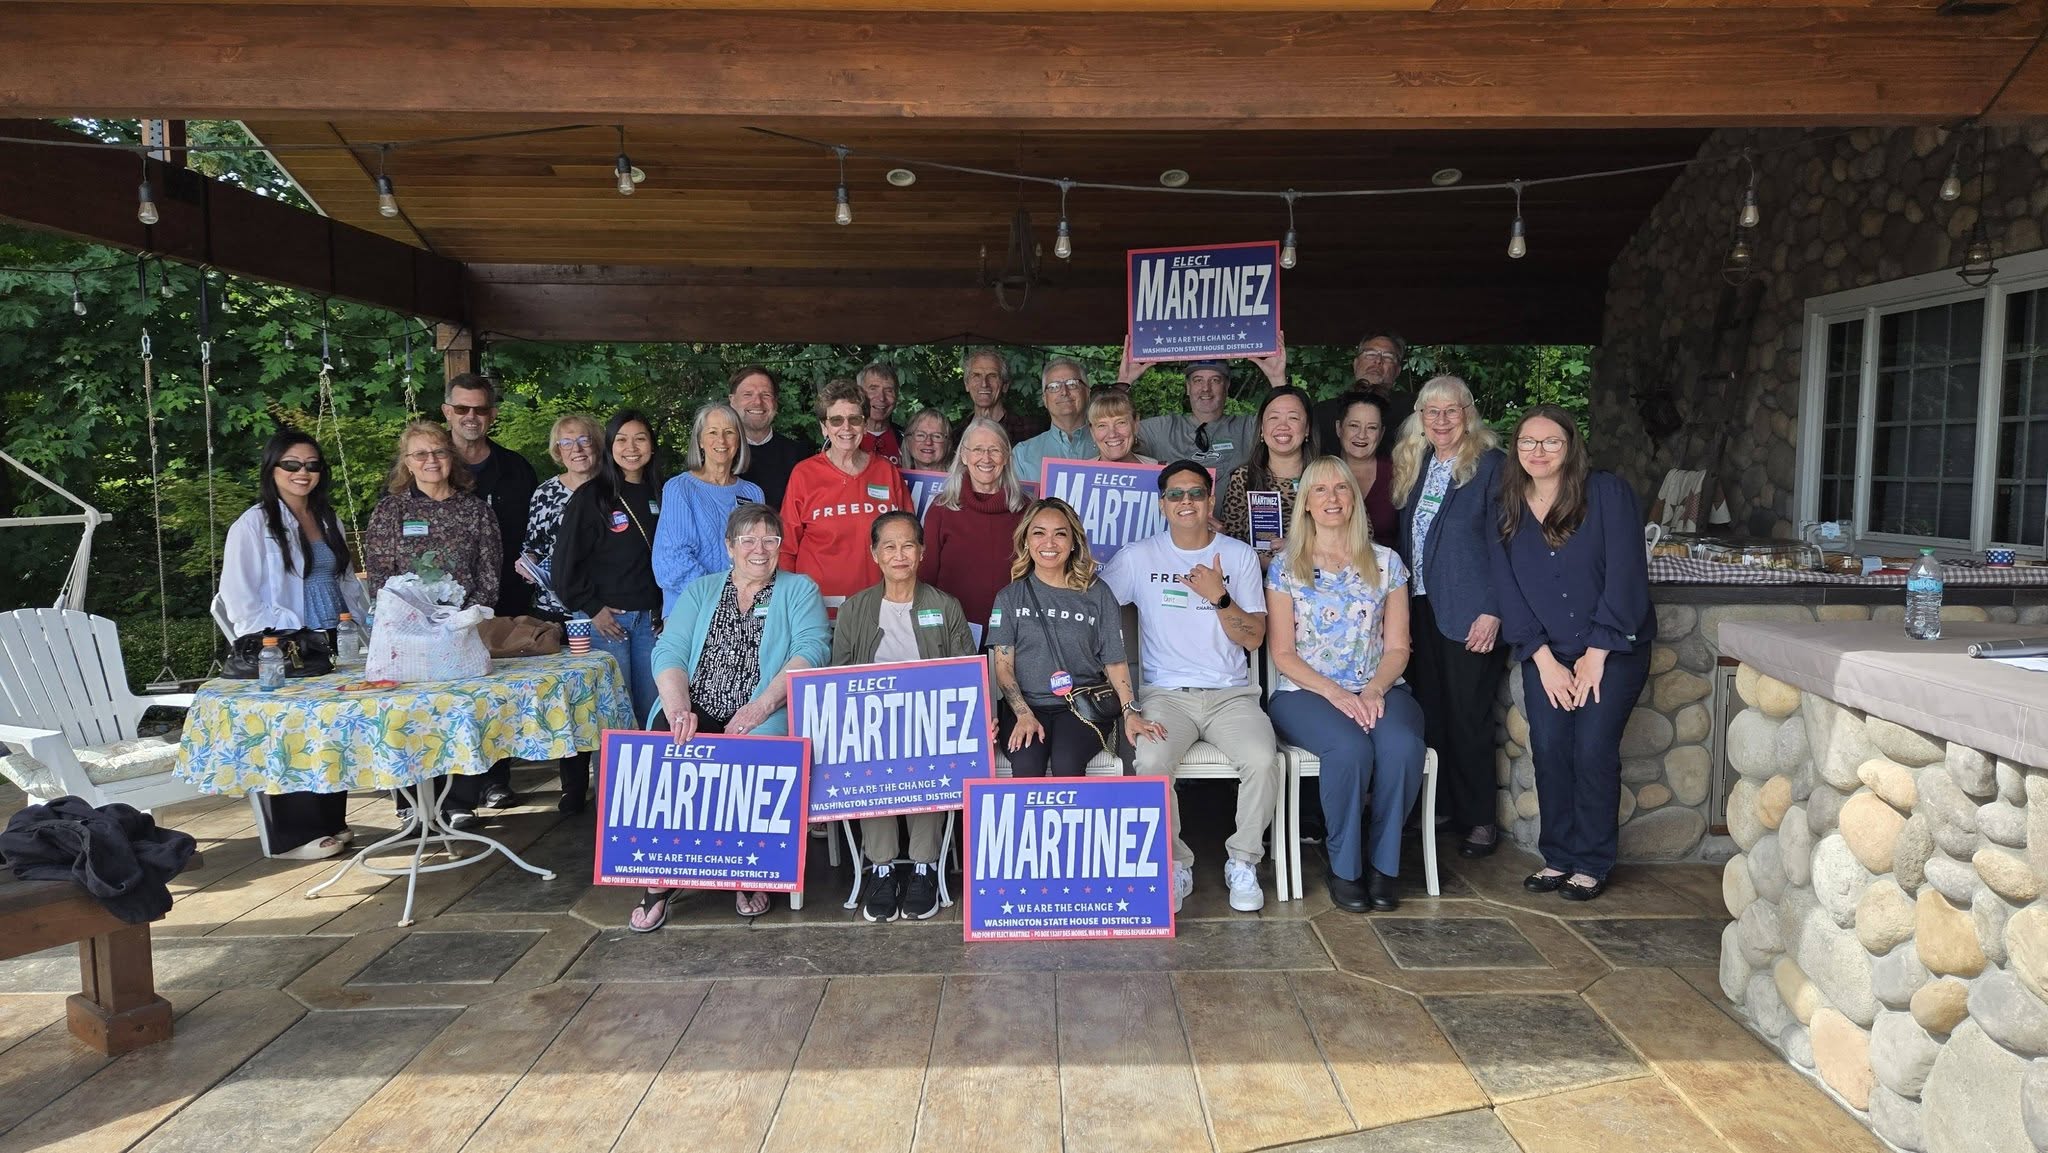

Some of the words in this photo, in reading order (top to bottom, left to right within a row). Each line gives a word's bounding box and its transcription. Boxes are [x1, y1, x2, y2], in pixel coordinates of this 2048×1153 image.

[1173, 255, 1211, 267] ELECT
[1136, 258, 1272, 322] MARTINEZ
[1142, 346, 1184, 354] WASHINGTON
[1094, 473, 1137, 487] ELECT
[812, 503, 898, 520] FREEDOM
[1016, 608, 1095, 626] FREDOM
[848, 676, 897, 692] ELECT
[802, 682, 978, 765] MARTINEZ
[664, 744, 716, 758] ELECT
[608, 743, 797, 834] MARTINEZ
[843, 787, 857, 796] WE
[859, 785, 878, 794] ARE
[879, 784, 896, 792] THE
[898, 780, 936, 791] CHANGE
[811, 799, 867, 811] WASHINGTON
[868, 797, 893, 806] STATE
[894, 794, 922, 804] HOUSE
[926, 791, 962, 801] DISTRICT
[1026, 791, 1077, 805] ELECT
[976, 793, 1160, 880] MARTINEZ
[648, 853, 663, 862] WE
[664, 854, 683, 862] ARE
[685, 854, 703, 863] THE
[704, 855, 743, 864] CHANGE
[615, 865, 672, 875] WASHINGTON
[673, 867, 698, 876] STATE
[699, 868, 728, 877] HOUSE
[731, 869, 768, 878] DISTRICT
[769, 871, 779, 879] 33
[1017, 904, 1032, 912] WE
[1034, 903, 1052, 912] ARE
[1054, 903, 1072, 912] THE
[1074, 902, 1113, 912] CHANGE
[984, 919, 1042, 927] WASHINGTON
[1043, 918, 1068, 926] STATE
[1070, 918, 1099, 926] HOUSE
[1102, 917, 1140, 925] DISTRICT
[1141, 916, 1151, 924] 33
